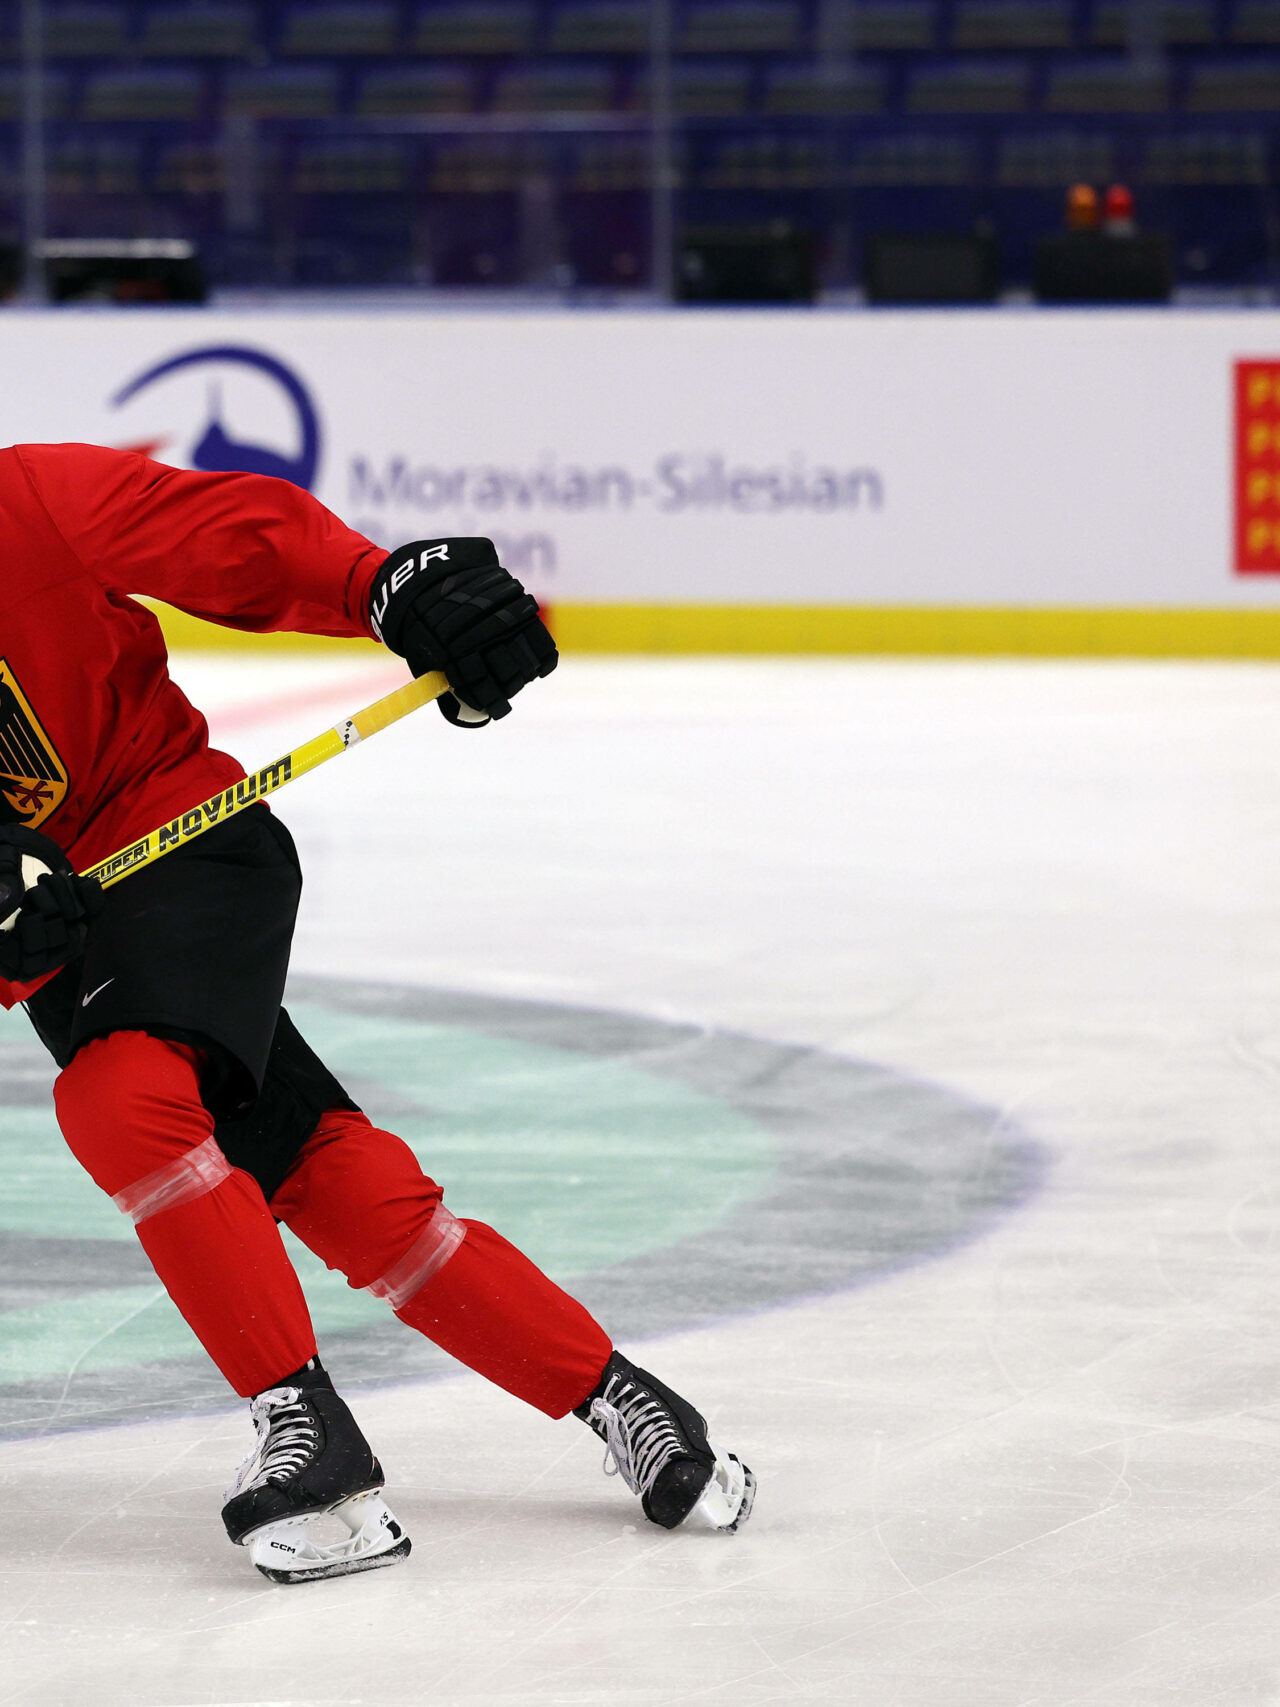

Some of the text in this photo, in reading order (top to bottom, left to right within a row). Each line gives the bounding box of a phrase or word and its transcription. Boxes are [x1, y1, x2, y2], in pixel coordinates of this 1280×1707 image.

[347, 450, 887, 513] Moravian-Silesian
[159, 755, 292, 852] NOVIUM
[270, 1541, 296, 1554] CCM
